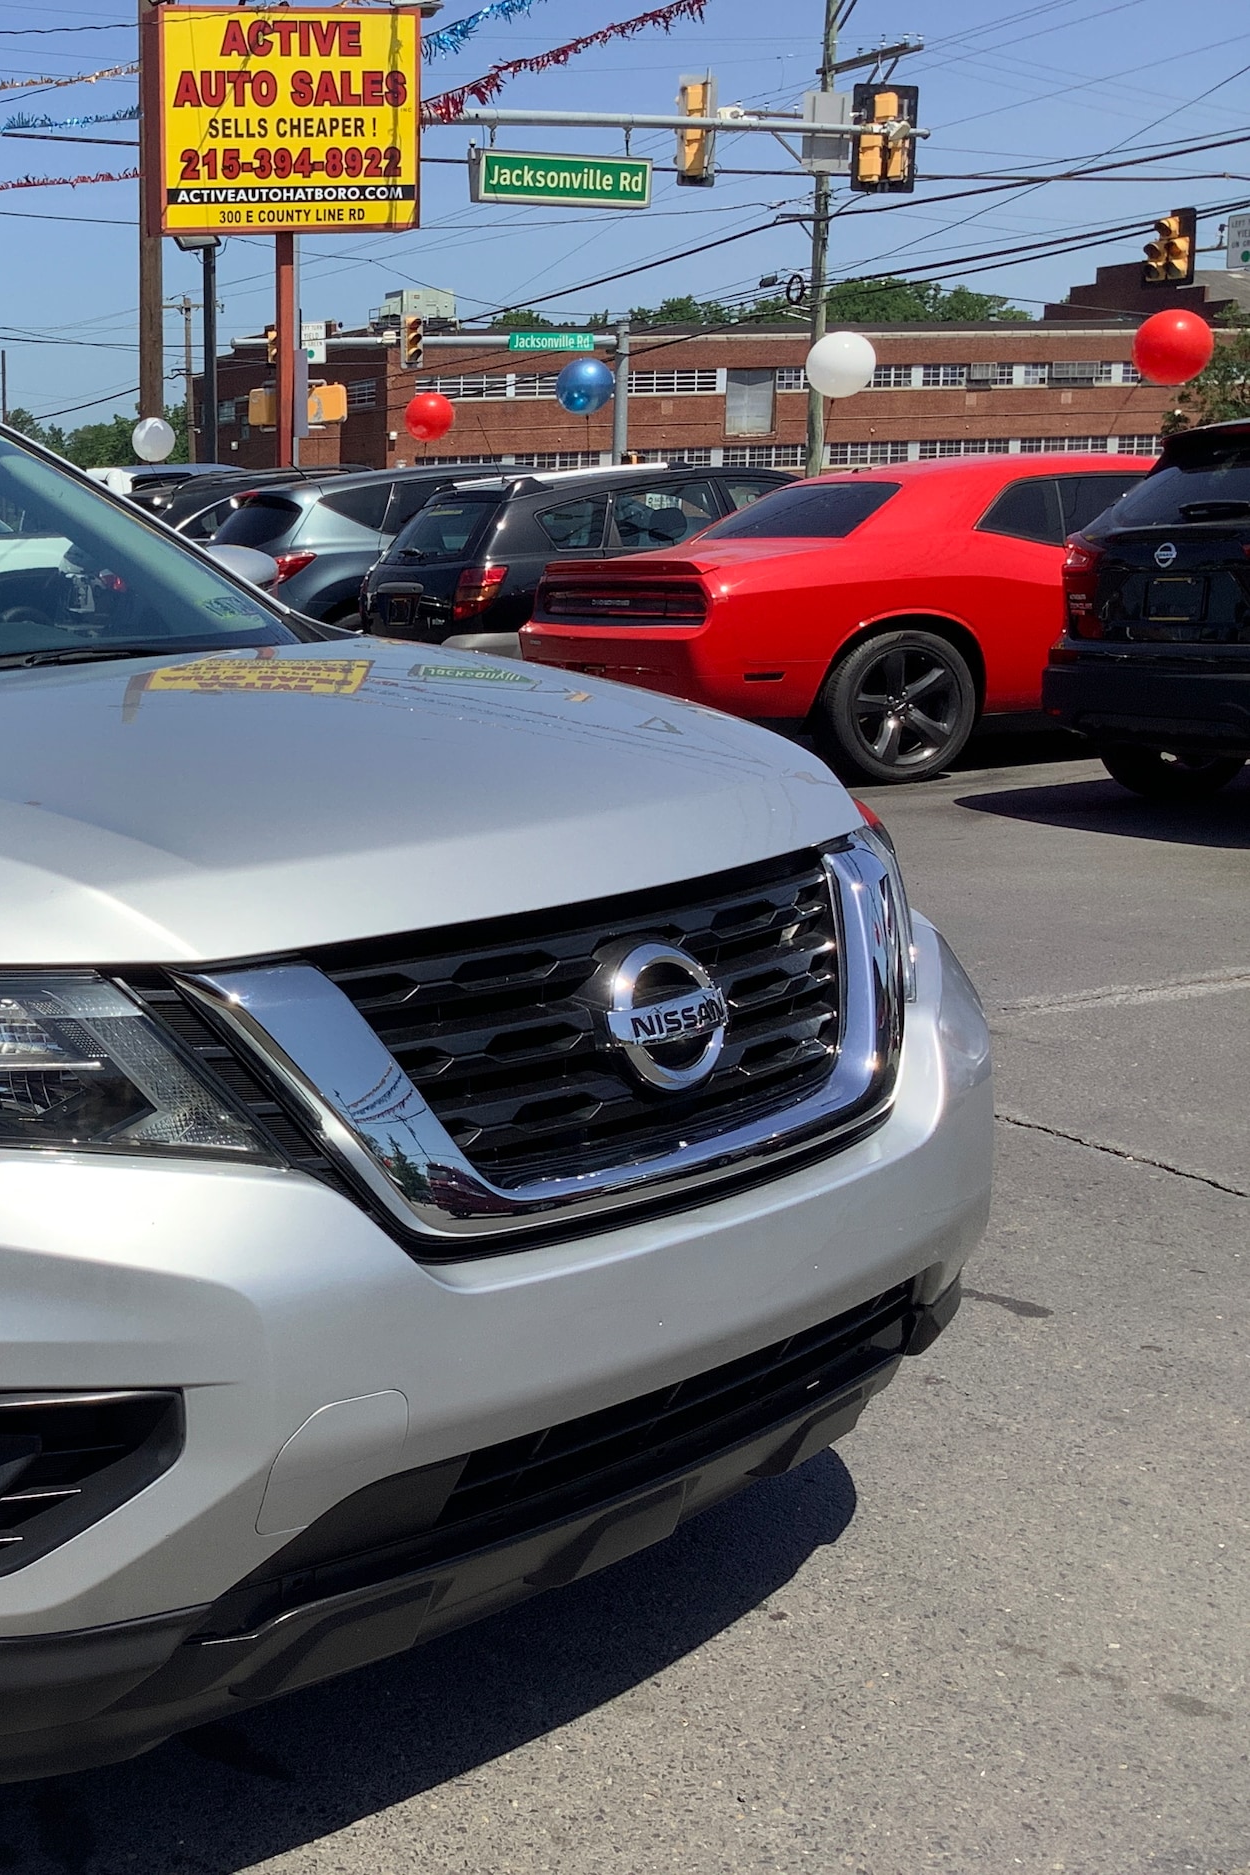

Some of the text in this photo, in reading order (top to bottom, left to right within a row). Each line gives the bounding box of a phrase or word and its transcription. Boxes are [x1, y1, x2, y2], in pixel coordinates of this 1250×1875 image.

[220, 20, 362, 57] ACTIVE
[173, 70, 407, 108] AUTO SALES
[208, 118, 268, 138] SELLS
[275, 117, 366, 138] CHEAPER
[179, 147, 402, 180] 215-394-8922
[489, 165, 642, 192] Jacksonville Rd
[177, 187, 403, 204] ACTIVEAUTOHATBORO.COM
[219, 208, 365, 223] 300 E COUNTY LINE RD
[514, 334, 590, 349] Jacksonville Rd
[630, 998, 725, 1039] NISSAN
